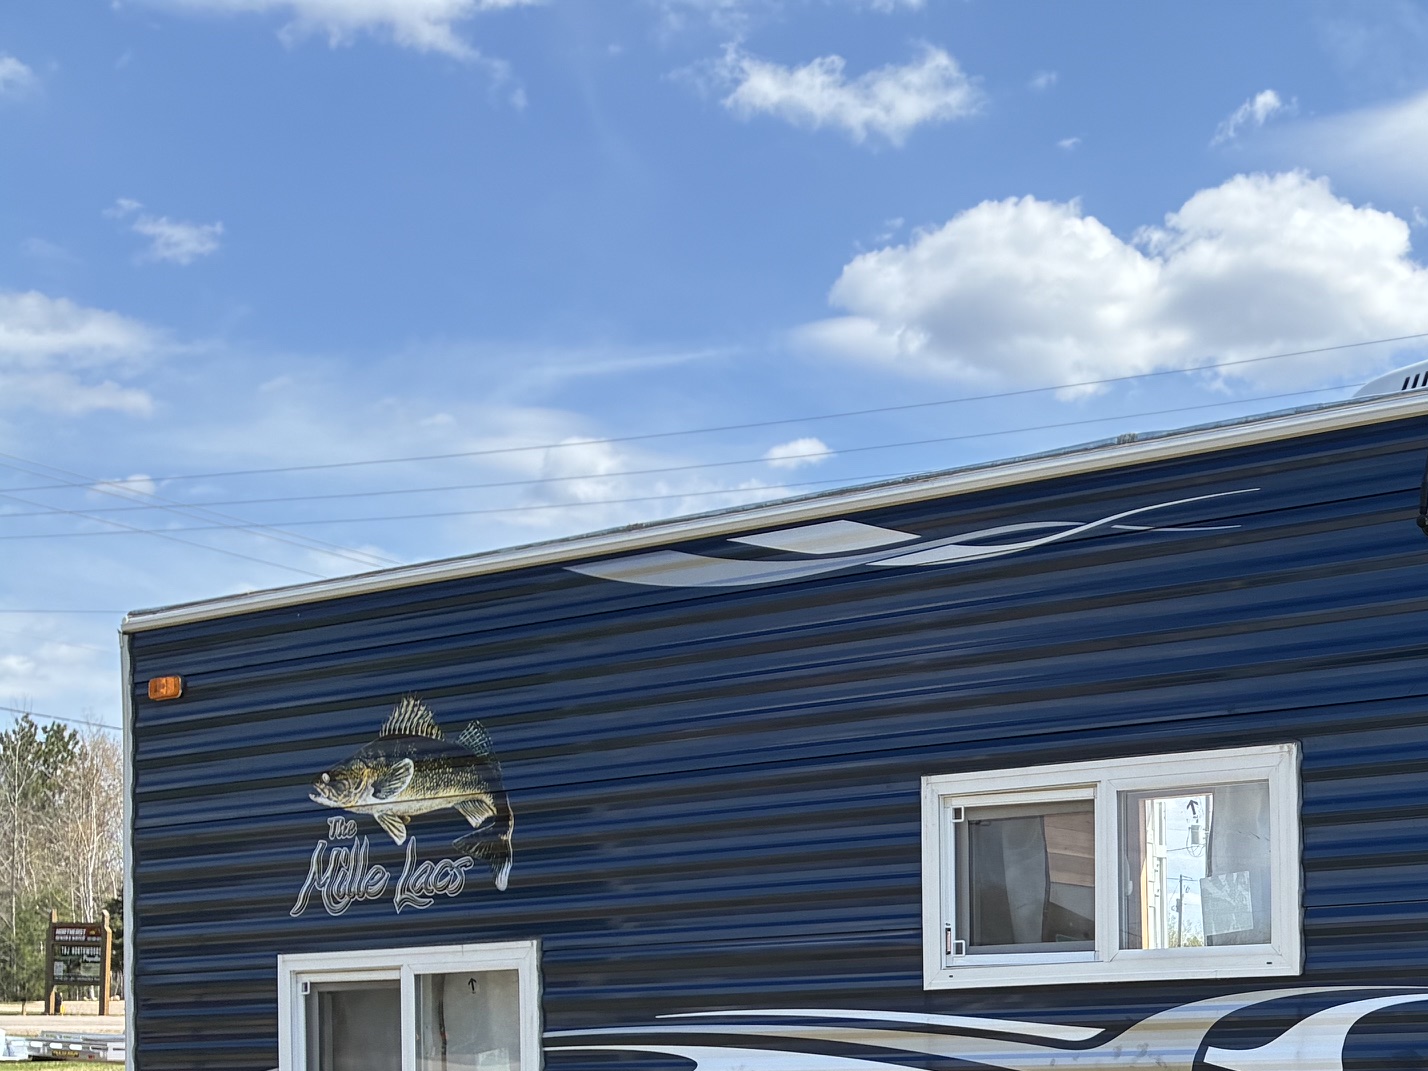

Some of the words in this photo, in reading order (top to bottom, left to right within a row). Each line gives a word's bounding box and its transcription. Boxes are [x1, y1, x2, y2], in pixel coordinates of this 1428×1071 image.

[327, 815, 357, 840] The
[290, 834, 391, 918] Mille
[393, 835, 474, 915] Lacs
